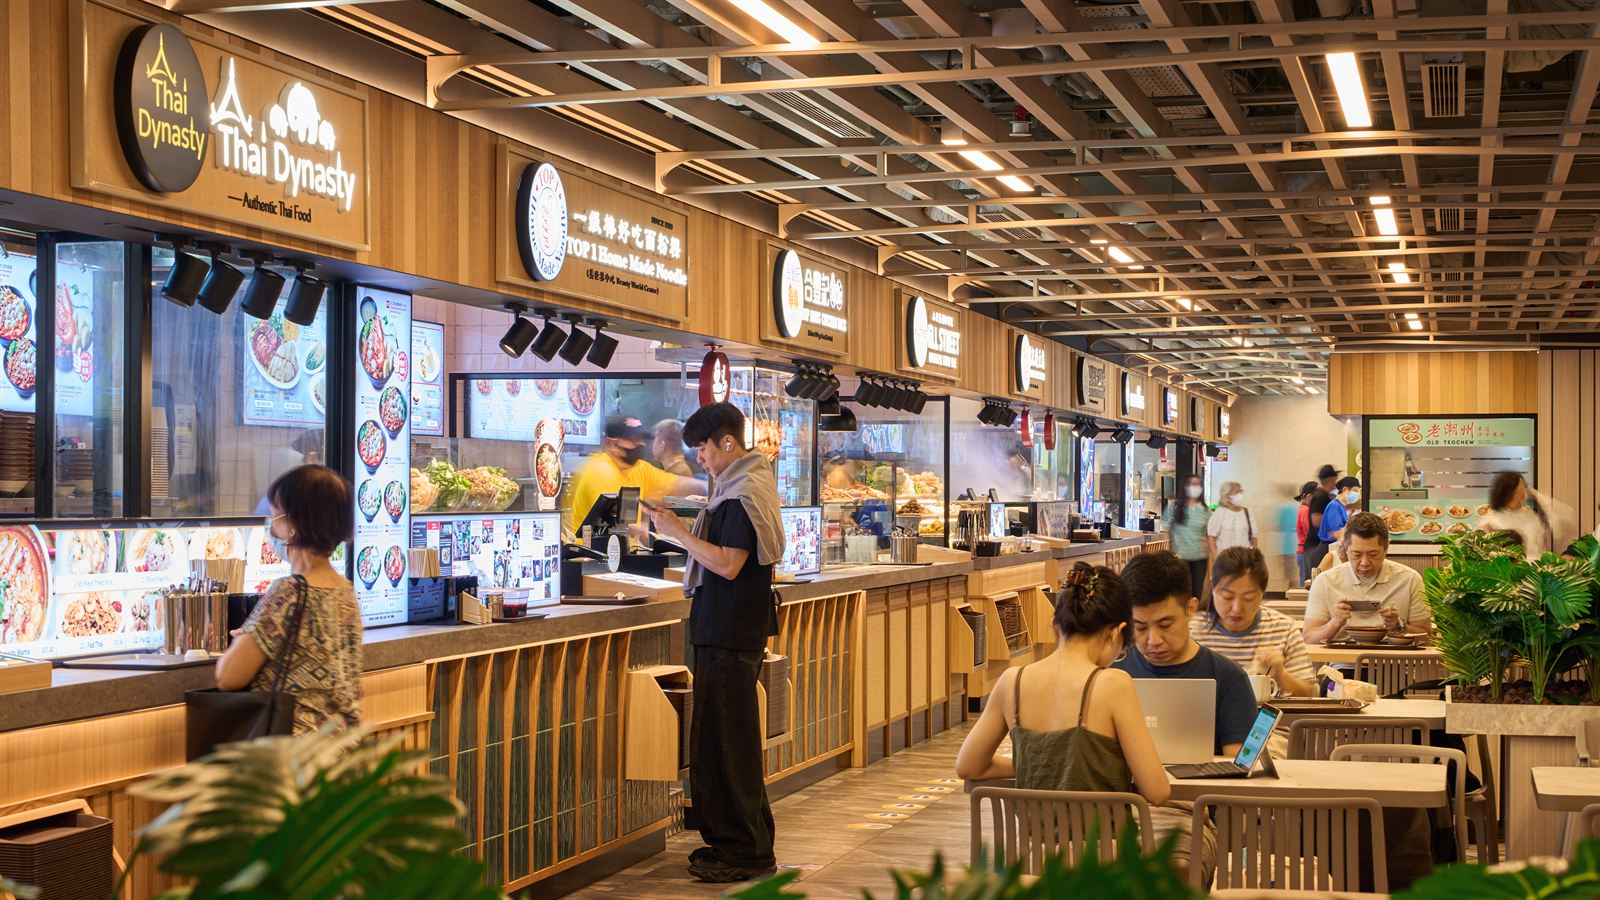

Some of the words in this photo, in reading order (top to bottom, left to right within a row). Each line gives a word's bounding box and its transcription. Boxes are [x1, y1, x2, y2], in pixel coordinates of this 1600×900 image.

[151, 78, 188, 115] Thai
[138, 108, 206, 161] Dynasty
[218, 121, 268, 177] Thai
[273, 141, 355, 211] Dynasty
[242, 192, 278, 216] Authentic
[279, 200, 293, 219] Thai
[294, 204, 312, 224] Food
[566, 235, 590, 258] TOP
[591, 243, 598, 261] 1
[598, 245, 629, 269] Home
[629, 253, 656, 276] Made
[656, 262, 688, 286] Noodle
[1425, 421, 1475, 440] 老潮州
